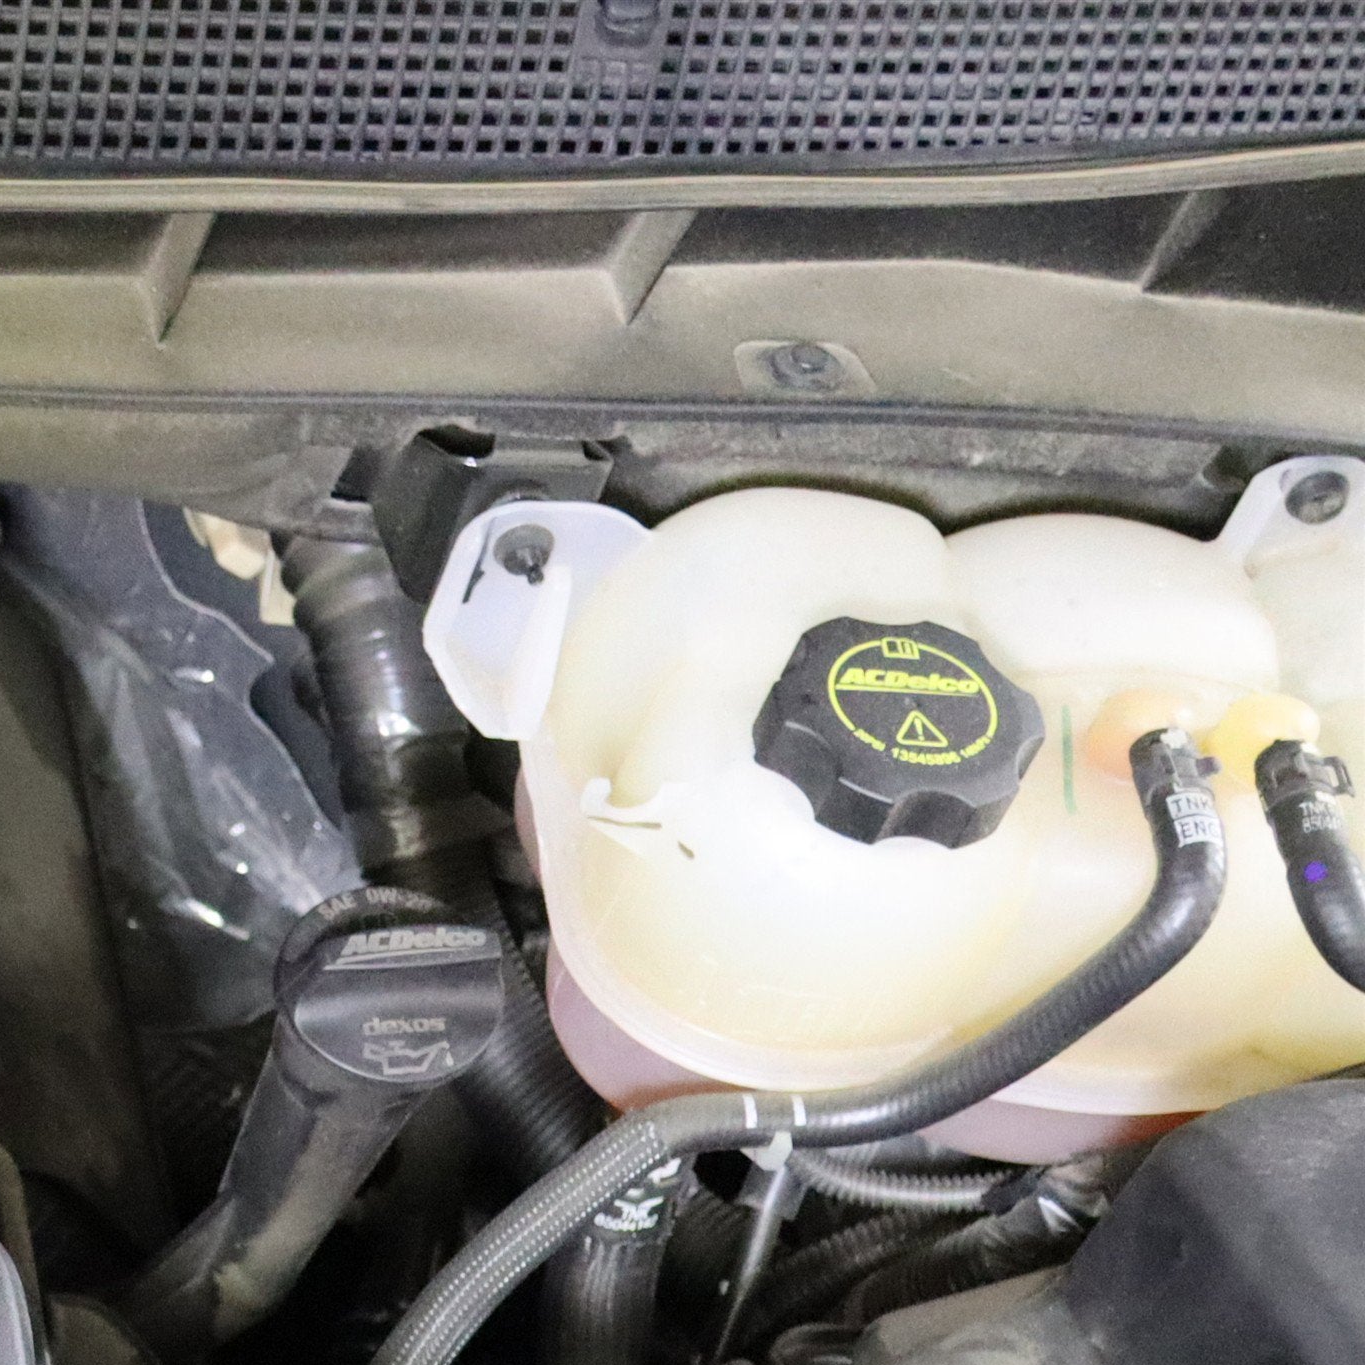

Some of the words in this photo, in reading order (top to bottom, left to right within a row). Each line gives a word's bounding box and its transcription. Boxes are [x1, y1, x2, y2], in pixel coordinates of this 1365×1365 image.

[839, 667, 980, 694] ACDelco
[339, 927, 487, 956] ACDelco
[362, 1017, 447, 1036] dexos
